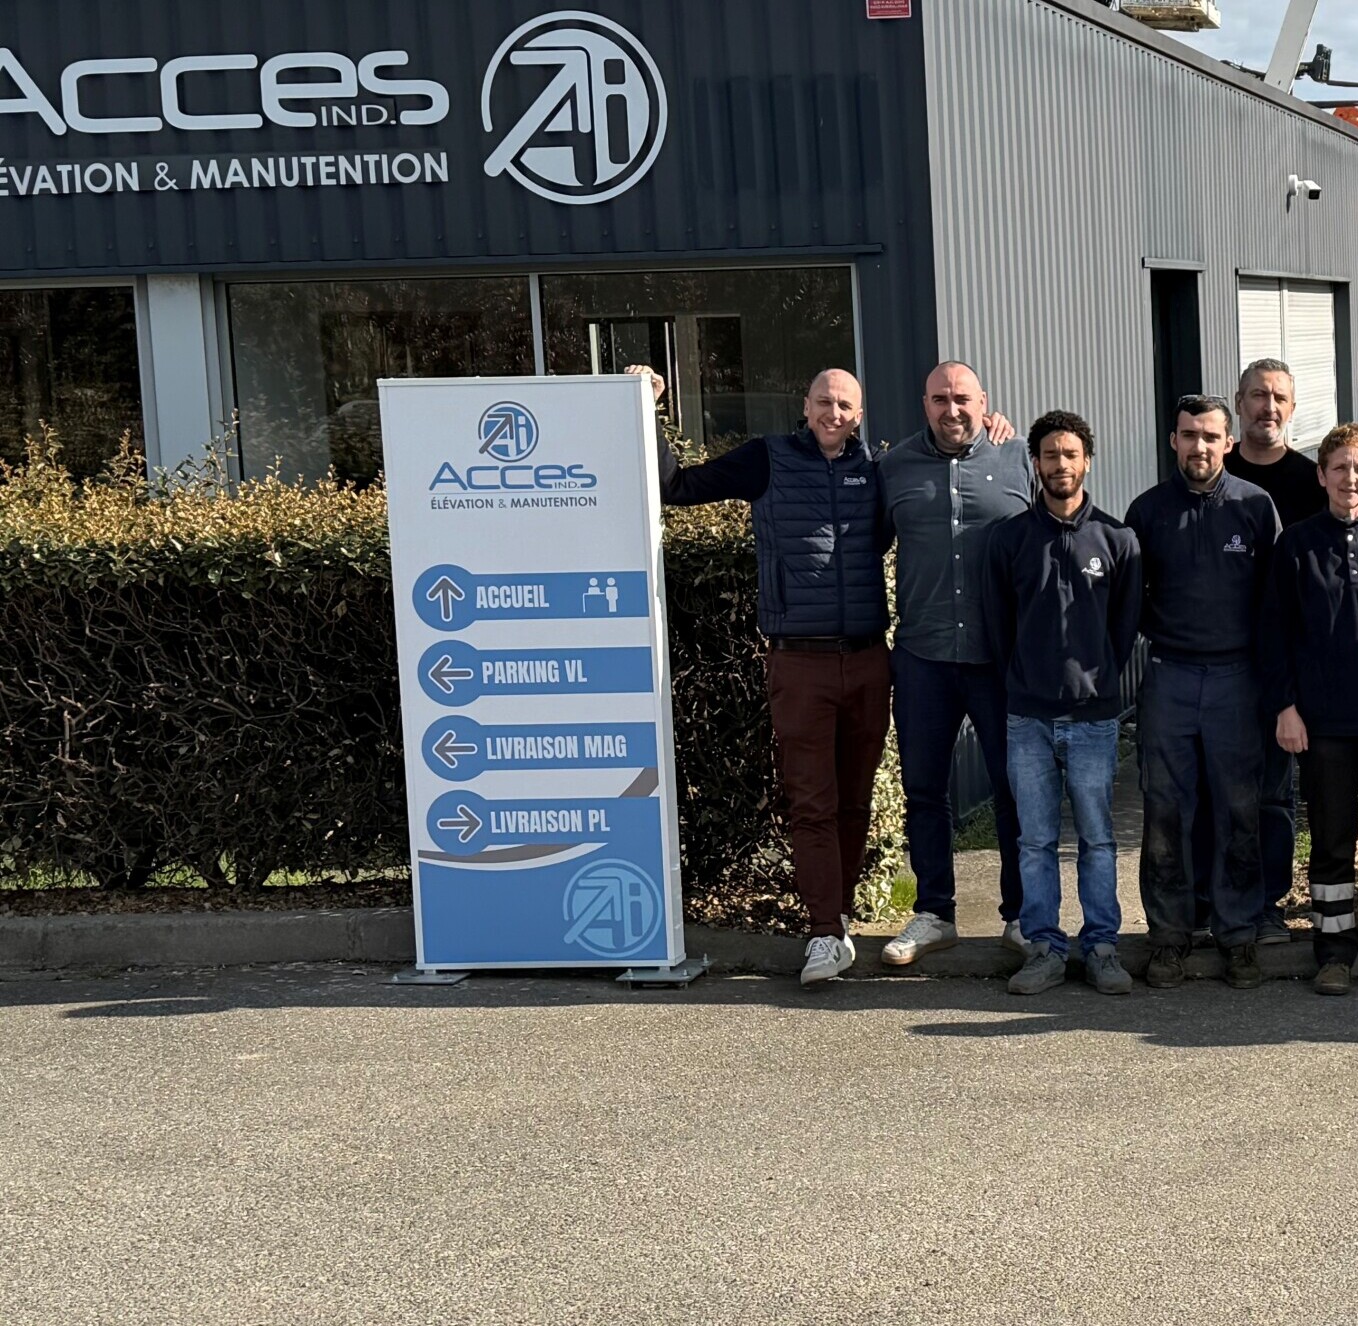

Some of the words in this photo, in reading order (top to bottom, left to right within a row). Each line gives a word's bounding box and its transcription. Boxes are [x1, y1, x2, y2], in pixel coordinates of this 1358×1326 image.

[320, 105, 396, 126] IND.
[154, 162, 178, 191] &
[191, 152, 449, 189] MANUTENTION
[554, 481, 580, 489] IND.
[430, 496, 494, 510] ÉLÉVATION
[498, 498, 507, 509] &
[510, 496, 597, 509] MANUTENTION
[476, 585, 550, 609] ACCUEIL
[482, 661, 560, 684] PARKING
[564, 660, 588, 683] VL
[486, 736, 579, 760] LIVRAISON
[584, 735, 627, 758] MAG
[490, 810, 583, 834] LIVRAISON
[588, 810, 610, 832] PL
